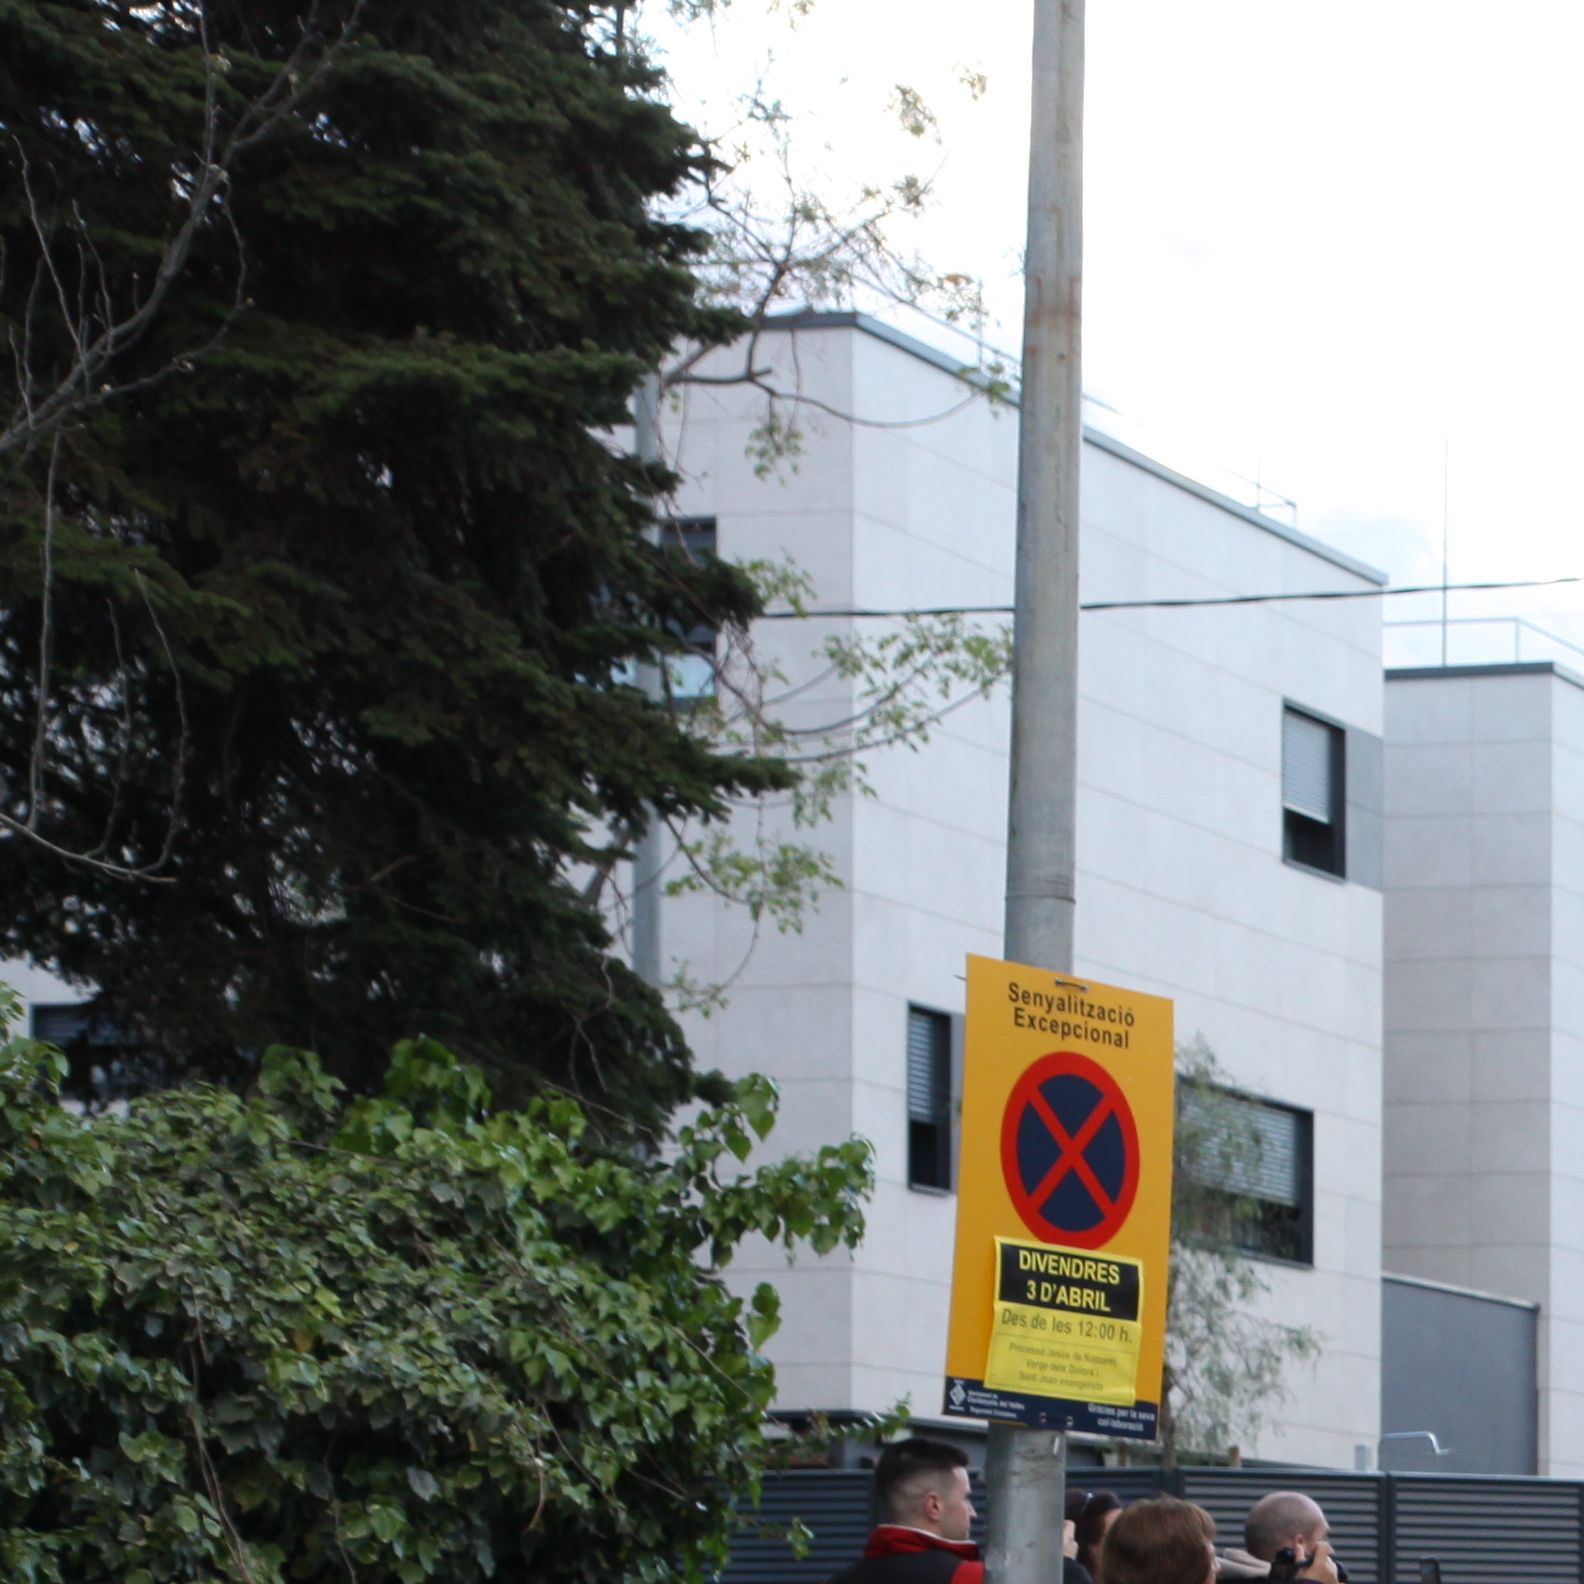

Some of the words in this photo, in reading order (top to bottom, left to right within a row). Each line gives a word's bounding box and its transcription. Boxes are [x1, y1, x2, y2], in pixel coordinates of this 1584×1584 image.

[1008, 982, 1135, 1027] Senyalització
[1014, 1006, 1130, 1049] Excepcional
[1019, 1249, 1121, 1285] DIVENDRES
[1026, 1279, 1037, 1300] 3
[1002, 1308, 1027, 1328] Des
[1031, 1314, 1047, 1331] de
[1052, 1317, 1072, 1334] les
[1078, 1320, 1115, 1339] 12:00
[1119, 1326, 1132, 1343] h.
